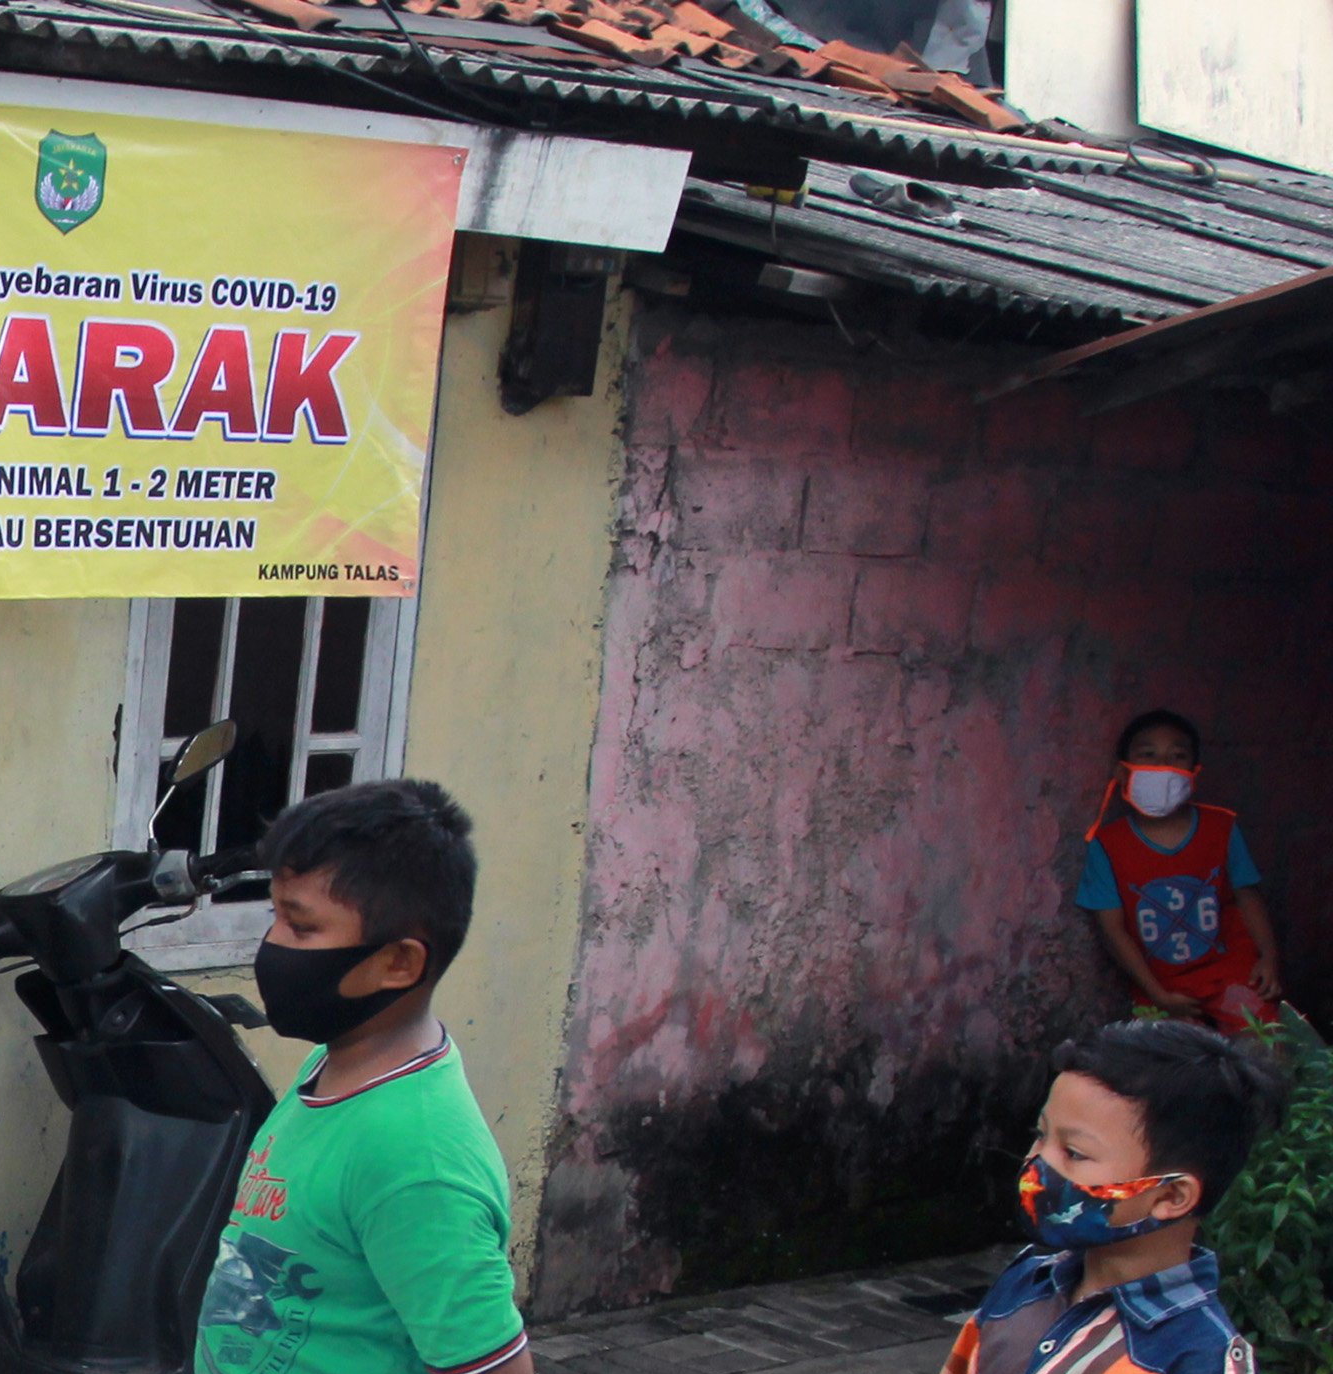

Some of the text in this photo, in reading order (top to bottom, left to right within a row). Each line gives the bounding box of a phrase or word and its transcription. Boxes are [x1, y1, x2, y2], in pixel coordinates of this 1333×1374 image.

[130, 270, 203, 306] Virus
[211, 277, 336, 313] COVID-19
[104, 469, 120, 499] 1
[147, 469, 165, 499] 2
[176, 469, 274, 502] METER
[34, 519, 256, 550] BERSENTUHAN
[257, 563, 400, 582] KAMPUNG TALAS
[1138, 909, 1158, 942] 6
[1198, 897, 1218, 931] 6
[1172, 932, 1190, 960] 3
